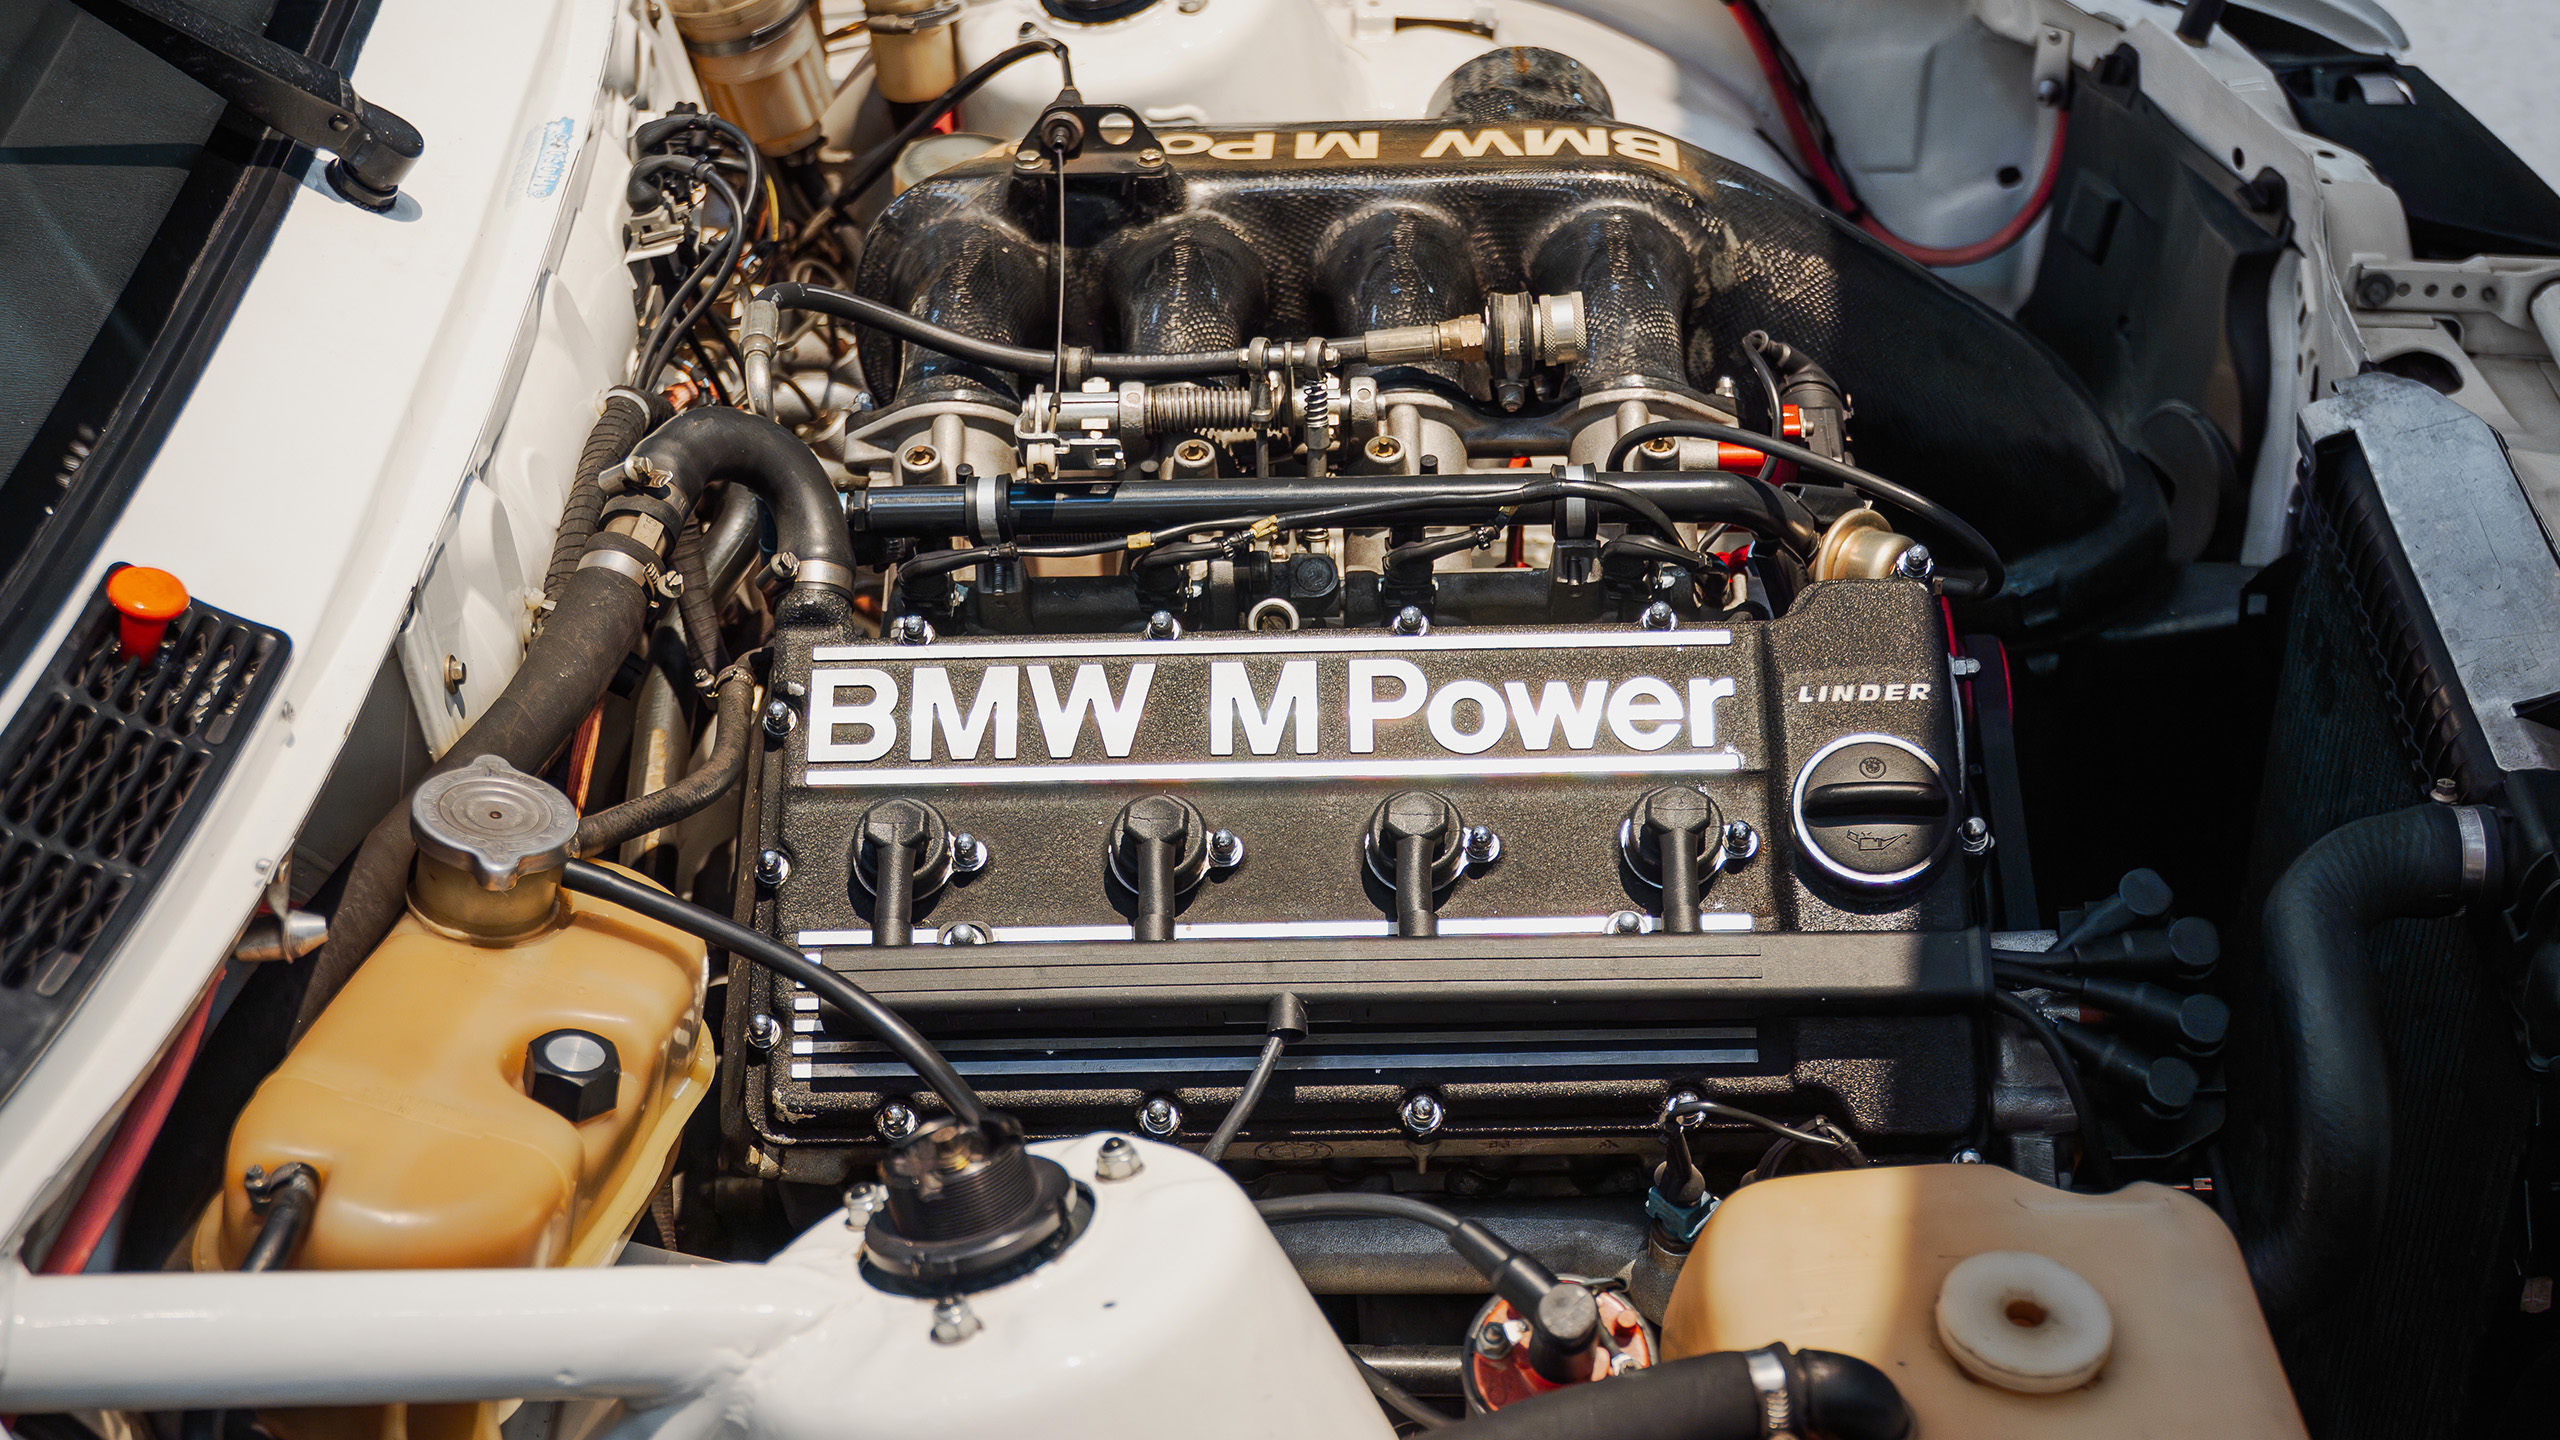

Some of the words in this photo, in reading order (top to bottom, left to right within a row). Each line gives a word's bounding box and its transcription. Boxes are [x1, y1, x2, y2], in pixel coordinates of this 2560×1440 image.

[1295, 130, 1380, 160] M
[1420, 127, 1680, 171] BMW
[1116, 354, 1142, 364] SAE
[1145, 353, 1167, 363] 100
[1797, 682, 1932, 705] LINDER
[807, 663, 1157, 762] BMW
[1209, 661, 1319, 757] M
[1349, 658, 1735, 755] Power
